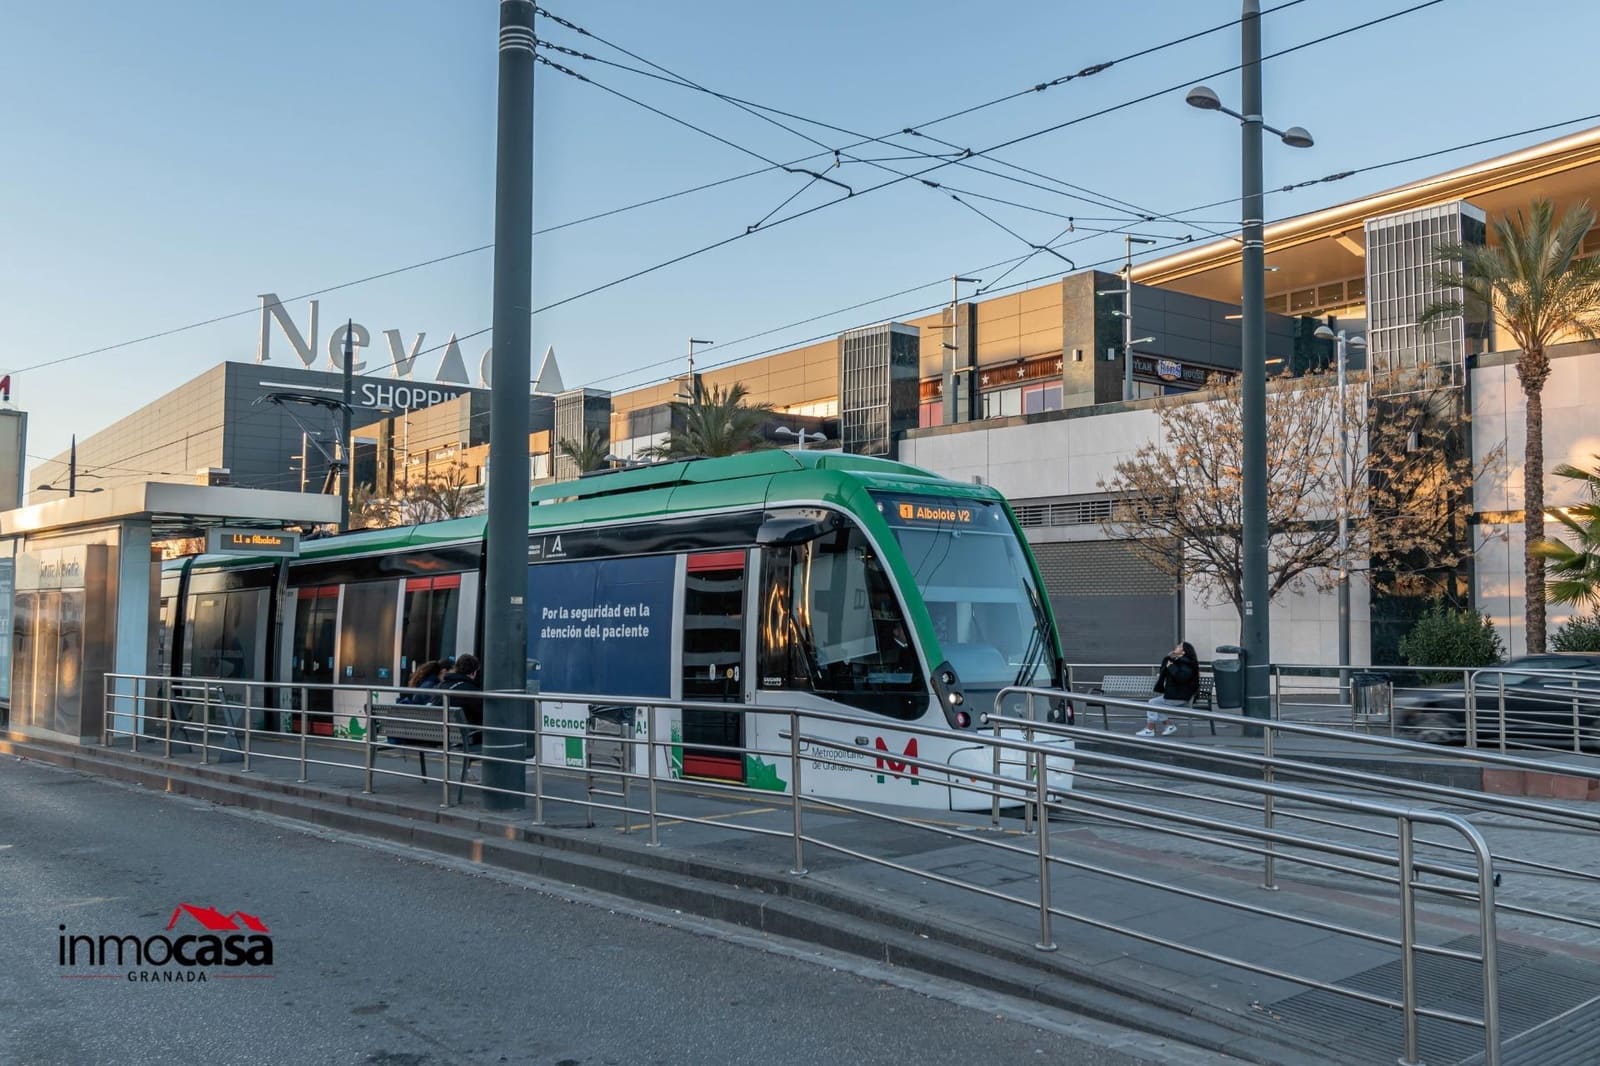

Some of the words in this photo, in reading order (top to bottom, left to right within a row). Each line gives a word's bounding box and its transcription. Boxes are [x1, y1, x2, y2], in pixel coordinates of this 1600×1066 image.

[917, 507, 956, 520] Albolote
[958, 510, 970, 521] V2
[542, 607, 558, 620] Por
[559, 606, 569, 619] la
[570, 604, 621, 621] seguridad
[623, 606, 637, 617] en
[639, 603, 650, 616] la
[541, 625, 582, 639] atención
[584, 625, 600, 638] del
[602, 624, 649, 641] paciente
[543, 715, 585, 730] Reconoc
